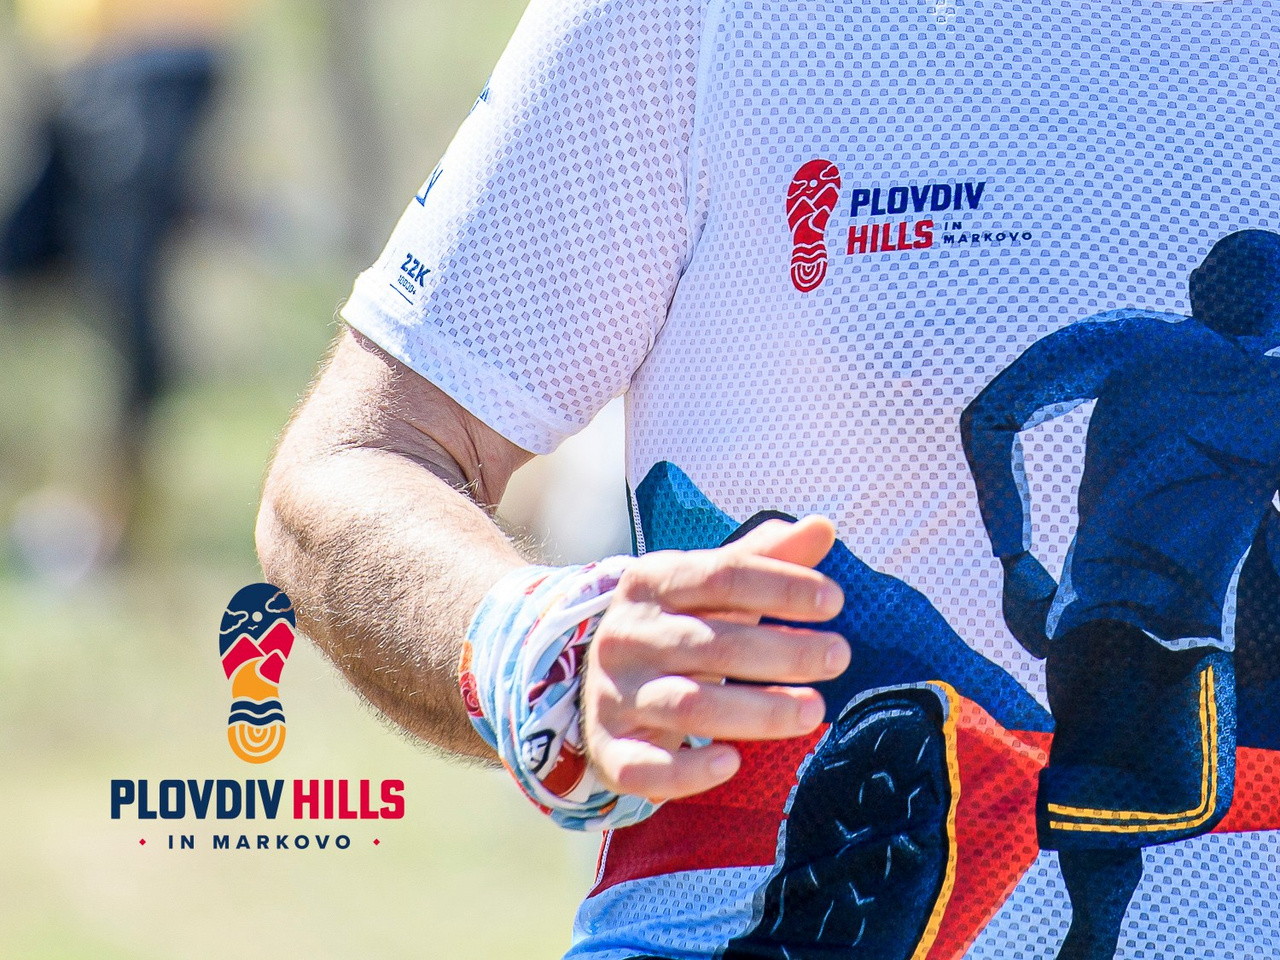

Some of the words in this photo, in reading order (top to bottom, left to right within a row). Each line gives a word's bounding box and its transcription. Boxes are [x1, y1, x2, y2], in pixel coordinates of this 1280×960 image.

[850, 181, 987, 218] PLOVDIV
[846, 219, 935, 255] HILLS
[943, 231, 1033, 244] MARKOVO
[944, 221, 962, 231] IN
[400, 252, 431, 287] 22K
